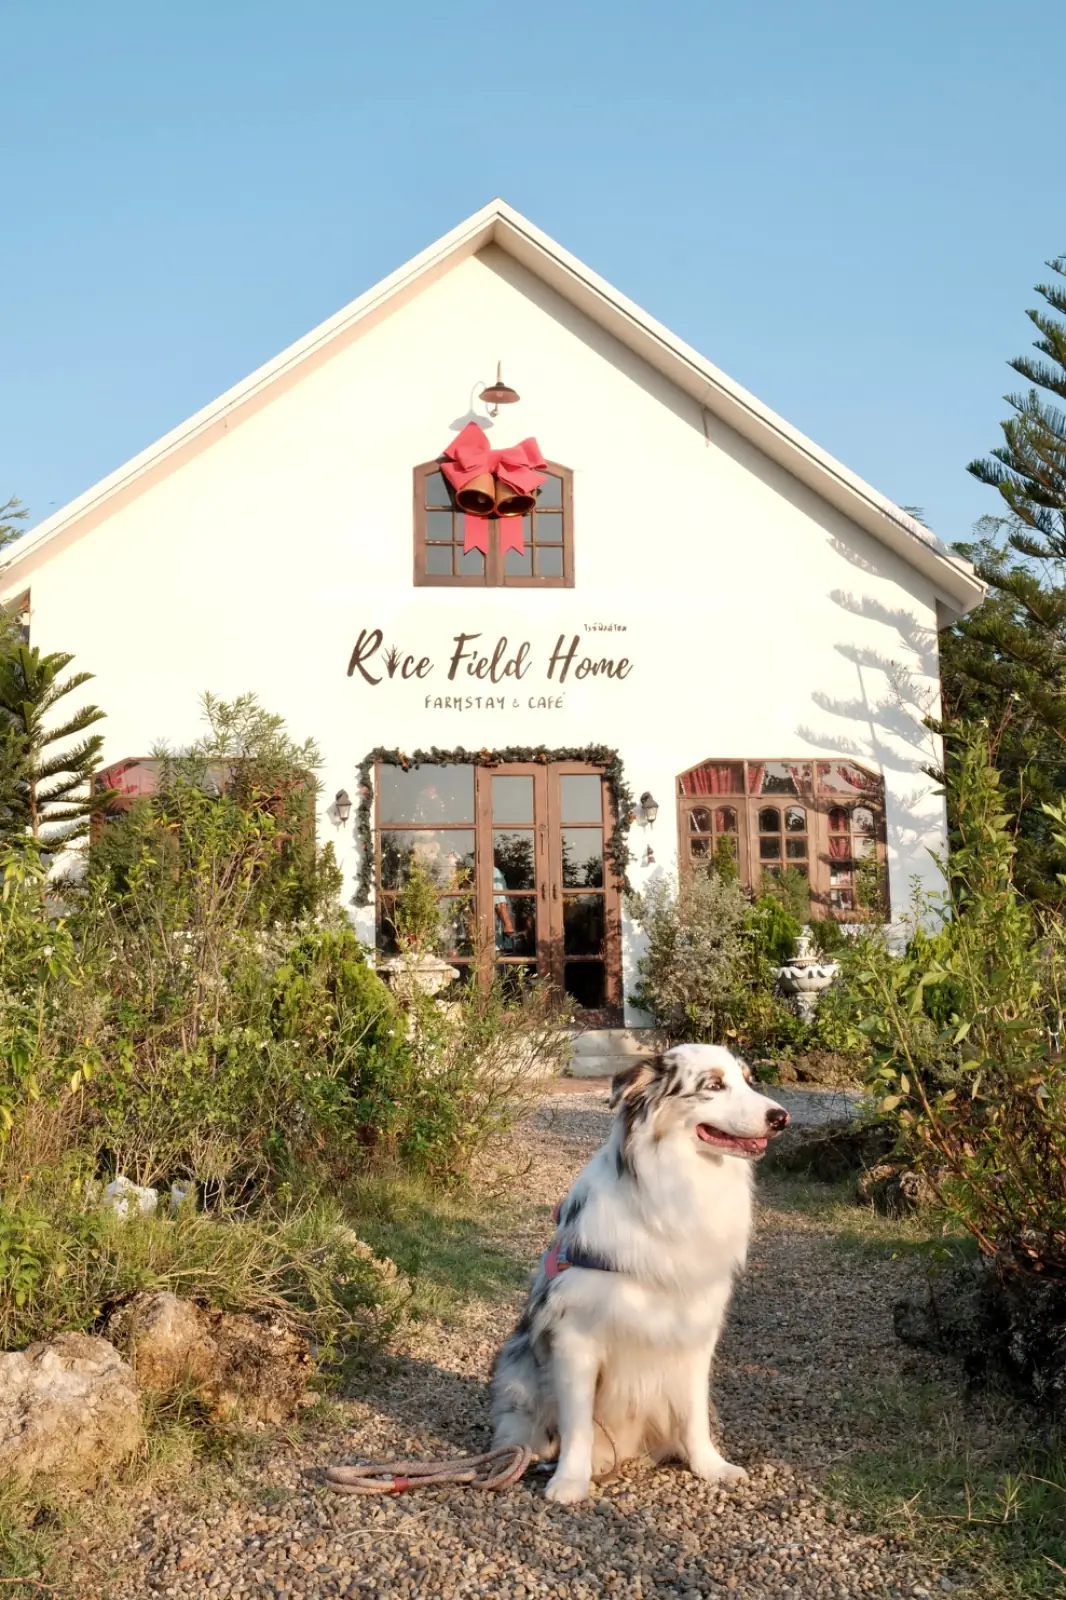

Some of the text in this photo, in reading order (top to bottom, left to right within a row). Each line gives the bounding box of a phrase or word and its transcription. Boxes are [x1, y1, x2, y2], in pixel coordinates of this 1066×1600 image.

[346, 628, 634, 686] Rice Field Home
[424, 694, 505, 713] FARMSTAY
[511, 697, 521, 709] &
